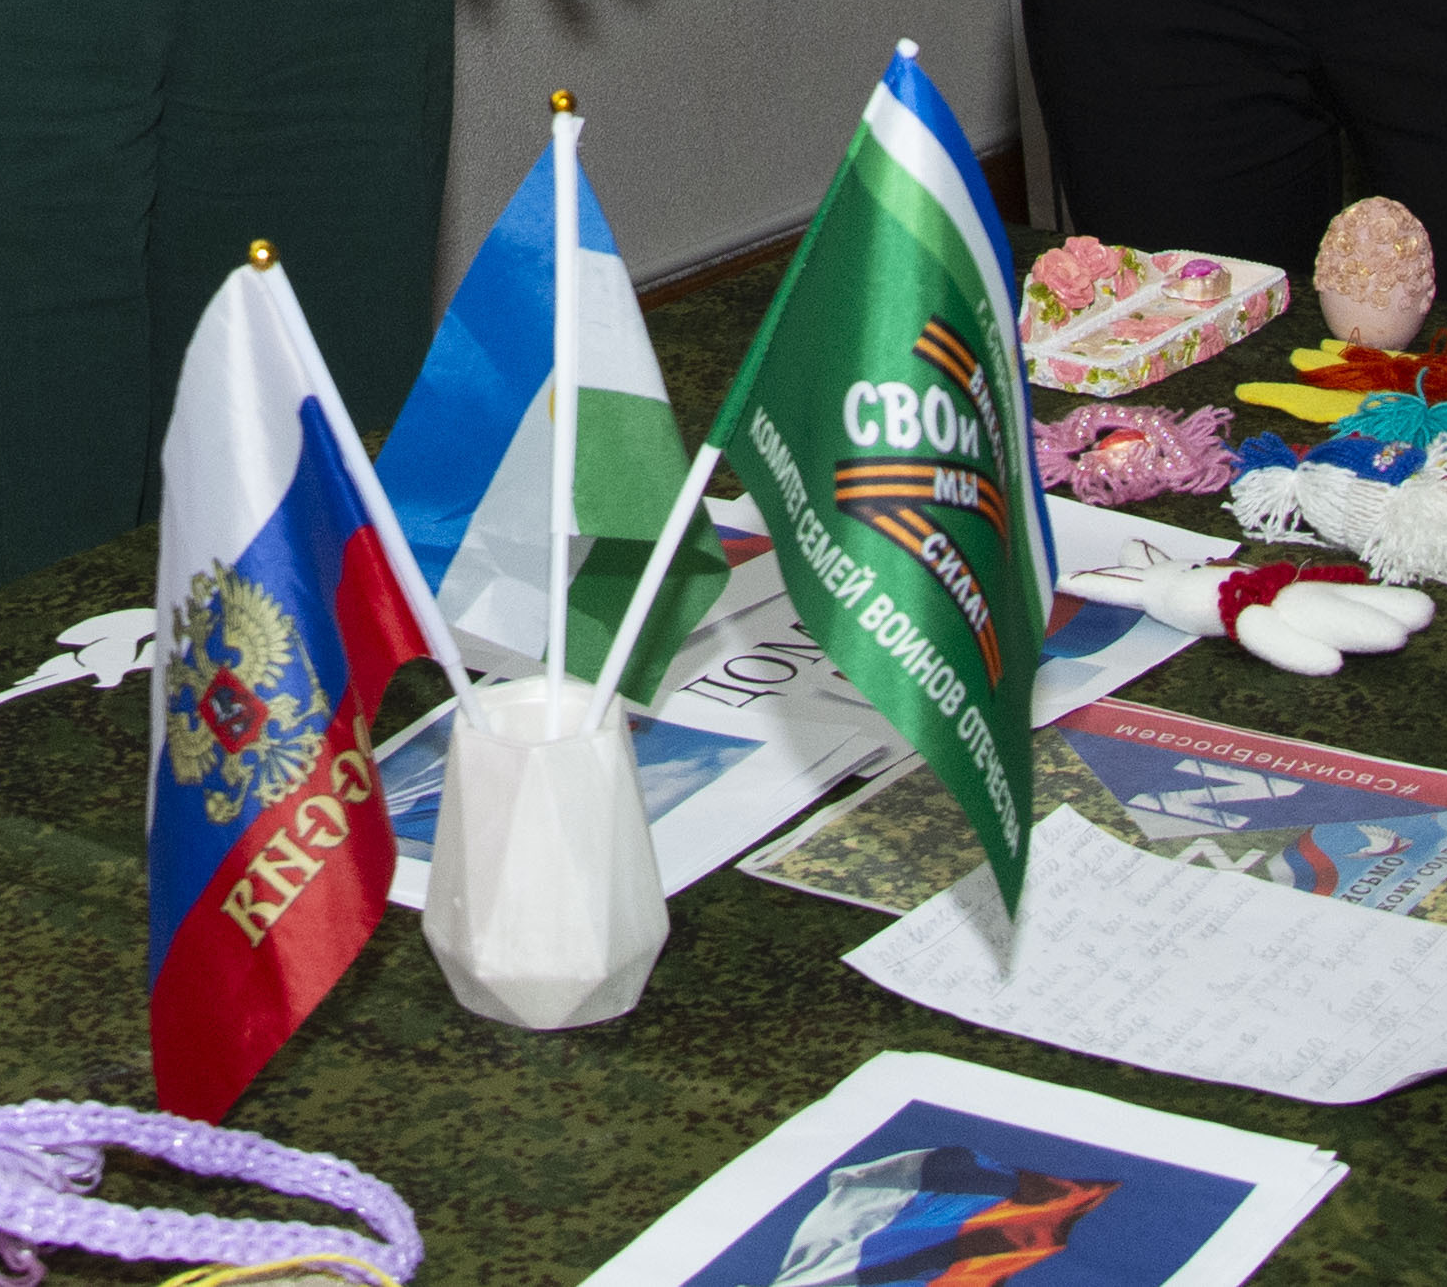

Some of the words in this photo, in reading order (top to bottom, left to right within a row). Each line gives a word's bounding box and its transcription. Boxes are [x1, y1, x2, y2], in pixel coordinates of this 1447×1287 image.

[932, 465, 981, 509] МЫ
[749, 404, 809, 525] КОМИТЕТ
[795, 507, 878, 610] СЕМЕЙ
[856, 592, 968, 718] ВОИНОВ
[920, 531, 990, 634] СИЛА!
[1340, 856, 1404, 904] ИСЬМО
[1375, 877, 1422, 912] КОМУ
